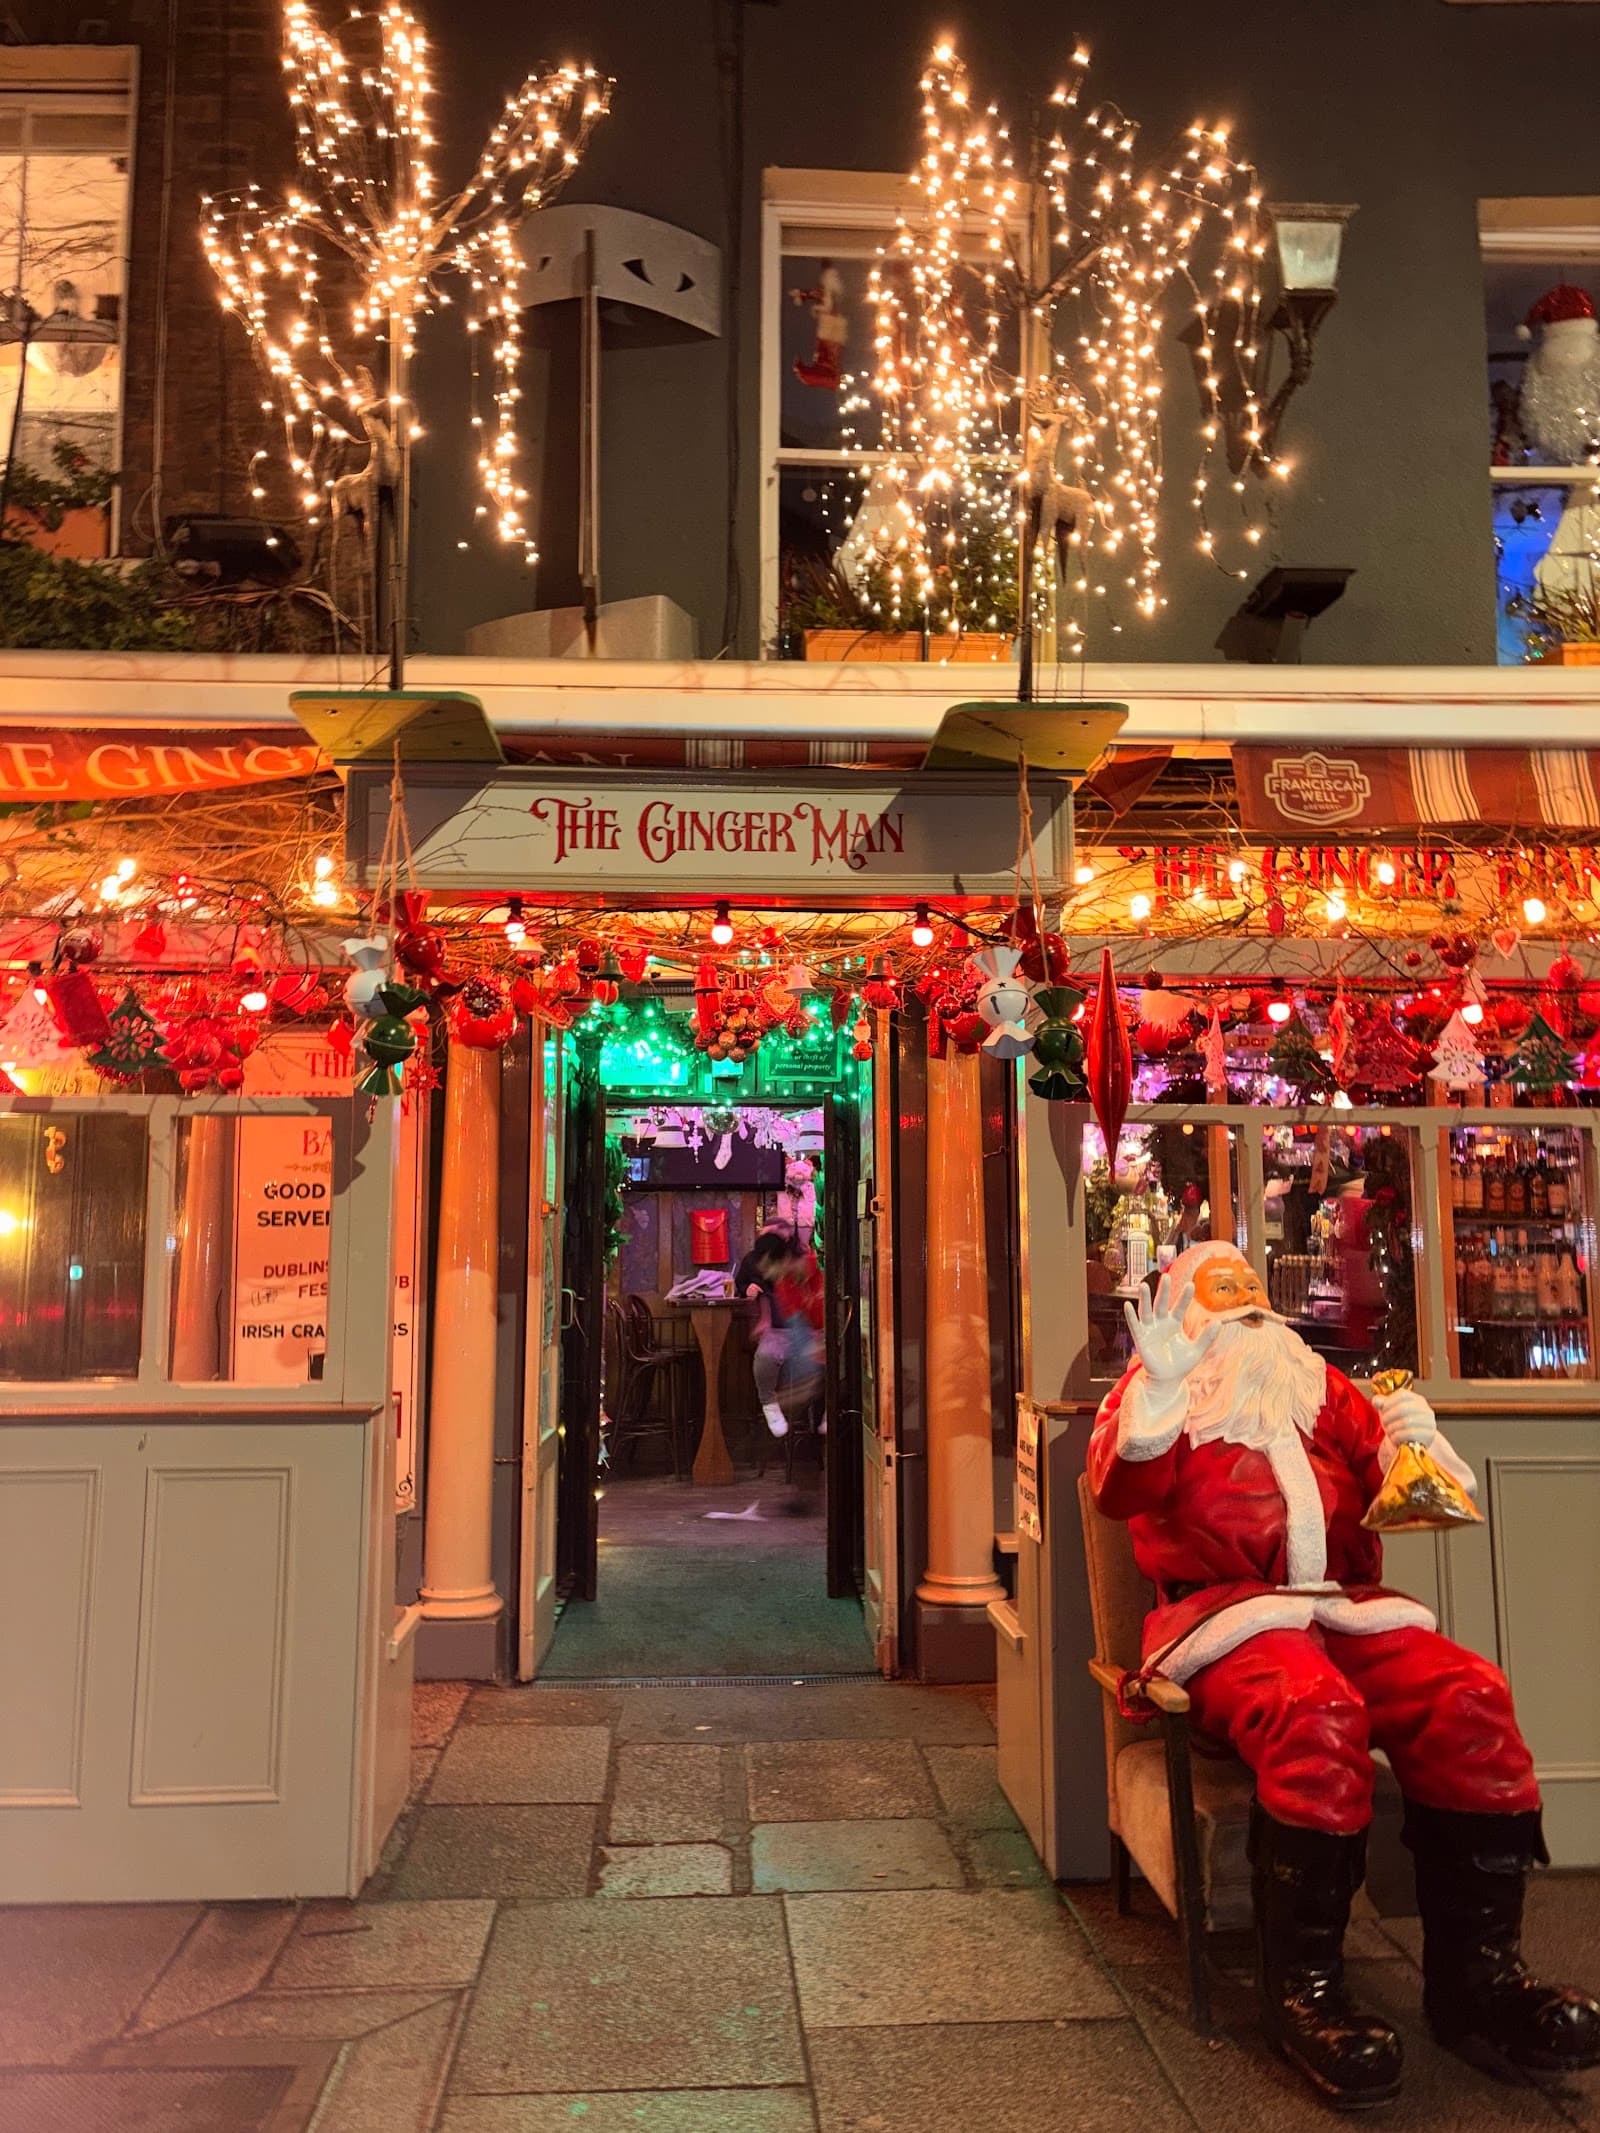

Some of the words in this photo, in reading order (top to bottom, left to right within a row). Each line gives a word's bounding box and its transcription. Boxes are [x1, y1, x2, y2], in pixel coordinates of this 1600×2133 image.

[1272, 779, 1364, 792] FRANCISCAN
[1300, 791, 1340, 803] WELL
[529, 797, 621, 864] THE
[637, 801, 797, 863] GINGER
[793, 802, 904, 870] MAN
[804, 1063, 832, 1071] property
[264, 1183, 326, 1200] GOOD
[242, 1324, 285, 1339] IRISH
[291, 1324, 325, 1339] CRA
